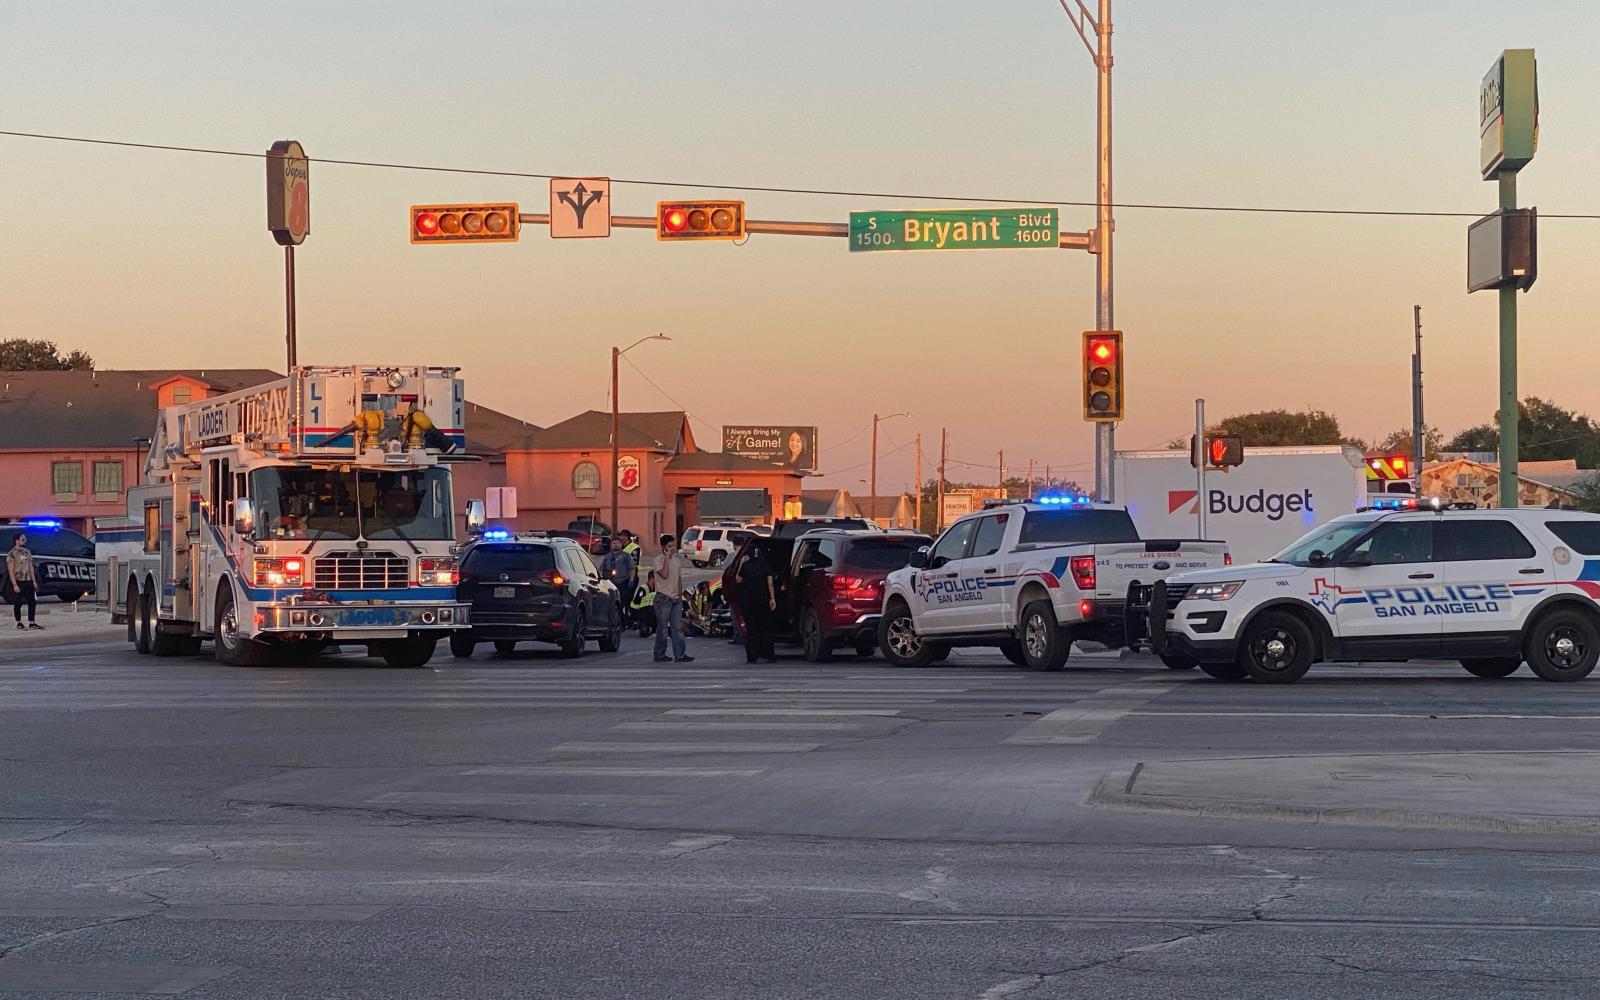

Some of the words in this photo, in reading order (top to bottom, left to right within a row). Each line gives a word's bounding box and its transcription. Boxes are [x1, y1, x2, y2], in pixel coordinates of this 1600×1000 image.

[289, 182, 307, 236] 8
[868, 217, 877, 229] S
[1019, 213, 1051, 227] Blvd
[857, 232, 892, 245] 1500
[904, 217, 1000, 248] Bryant
[1016, 229, 1051, 243] 1600
[310, 383, 322, 401] L
[455, 384, 461, 403] L
[198, 409, 223, 437] LADDER
[225, 407, 229, 431] 1
[310, 406, 319, 424] 1
[455, 408, 461, 426] 1
[730, 428, 752, 437] Always
[753, 428, 770, 436] Bring
[771, 428, 781, 436] My
[745, 437, 781, 448] Game!
[621, 468, 637, 487] 8
[1209, 489, 1314, 521] Budget
[47, 564, 96, 580] POLICE
[934, 577, 986, 594] POLICE
[937, 594, 953, 604] SAN
[954, 591, 983, 602] ANGELO
[1363, 584, 1513, 605] POLICE
[1374, 605, 1417, 618] SAN
[1423, 601, 1499, 615] ANGELO
